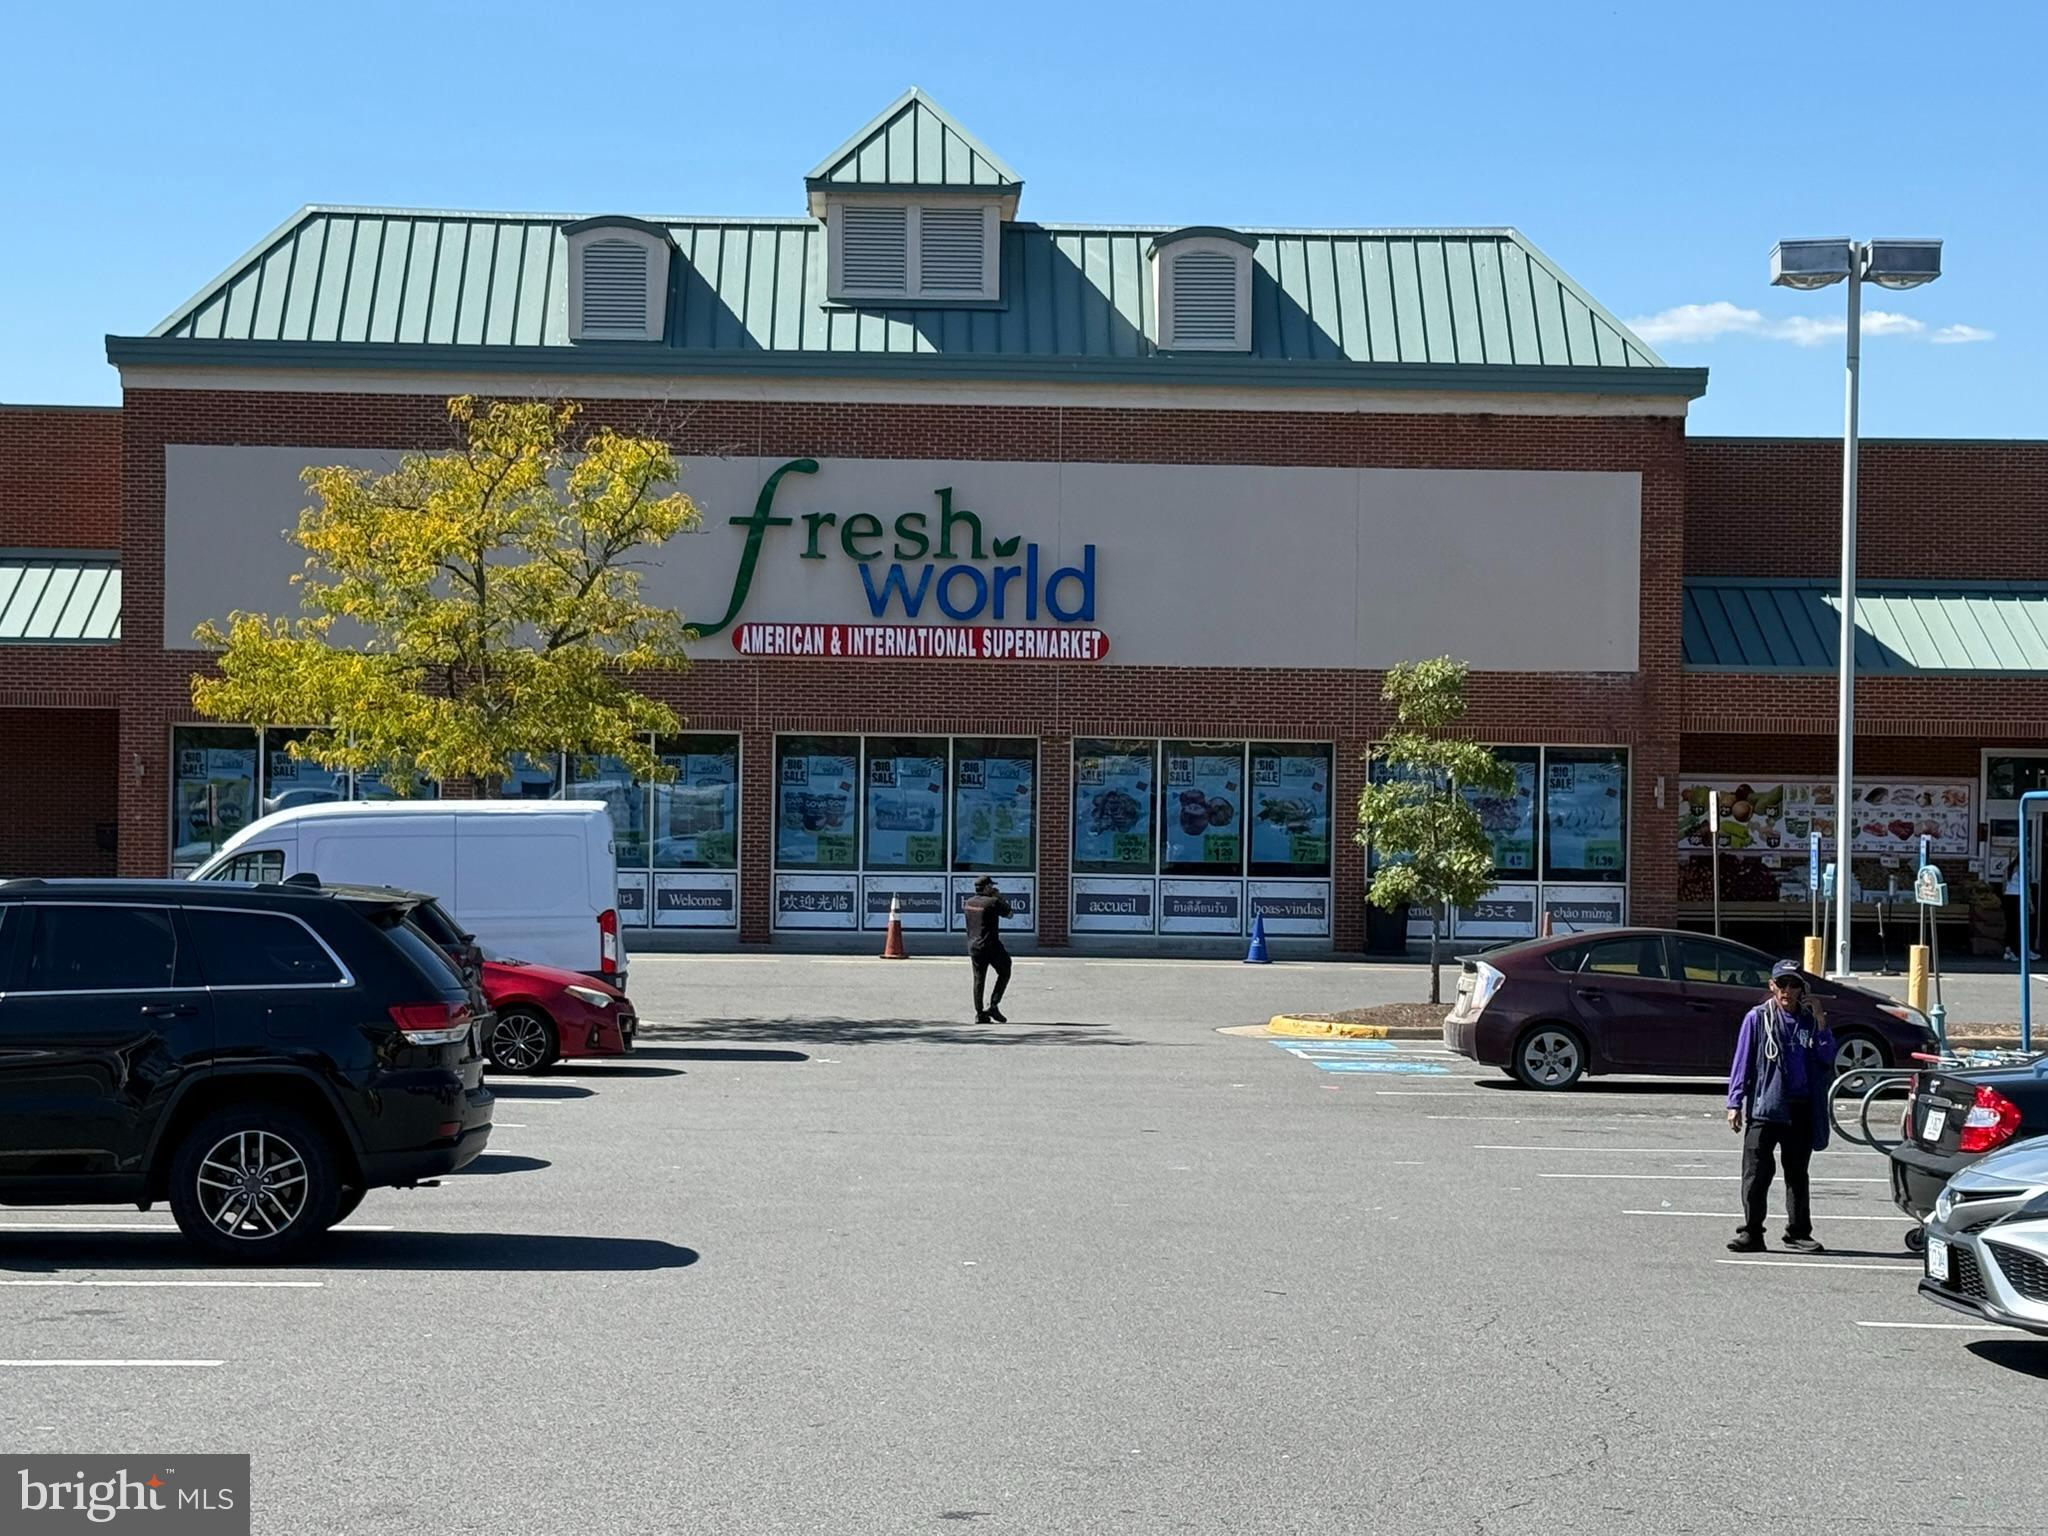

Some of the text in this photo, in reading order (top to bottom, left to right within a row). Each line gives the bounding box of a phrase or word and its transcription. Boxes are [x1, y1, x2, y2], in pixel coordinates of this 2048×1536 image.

[683, 457, 988, 637] fresh
[858, 543, 1096, 622] world
[740, 625, 1102, 660] AMERICAN & INTERNATIONAL SUPERMARKET
[182, 764, 206, 775] SALE
[786, 759, 803, 770] BIG
[1257, 760, 1275, 771] BIG
[273, 766, 296, 777] SALE
[783, 771, 806, 782] SALE
[1080, 770, 1102, 782] SALE
[871, 773, 894, 784] SALE
[960, 774, 982, 785] SALE
[1169, 772, 1192, 783] SALE
[1255, 772, 1278, 783] SALE
[1549, 779, 1572, 790] SALE
[669, 893, 722, 908] Welcome
[782, 895, 848, 911] 欢迎光临
[1089, 897, 1137, 912] accueil
[1253, 902, 1323, 916] boas-vindas
[1474, 904, 1517, 918] ようこそ
